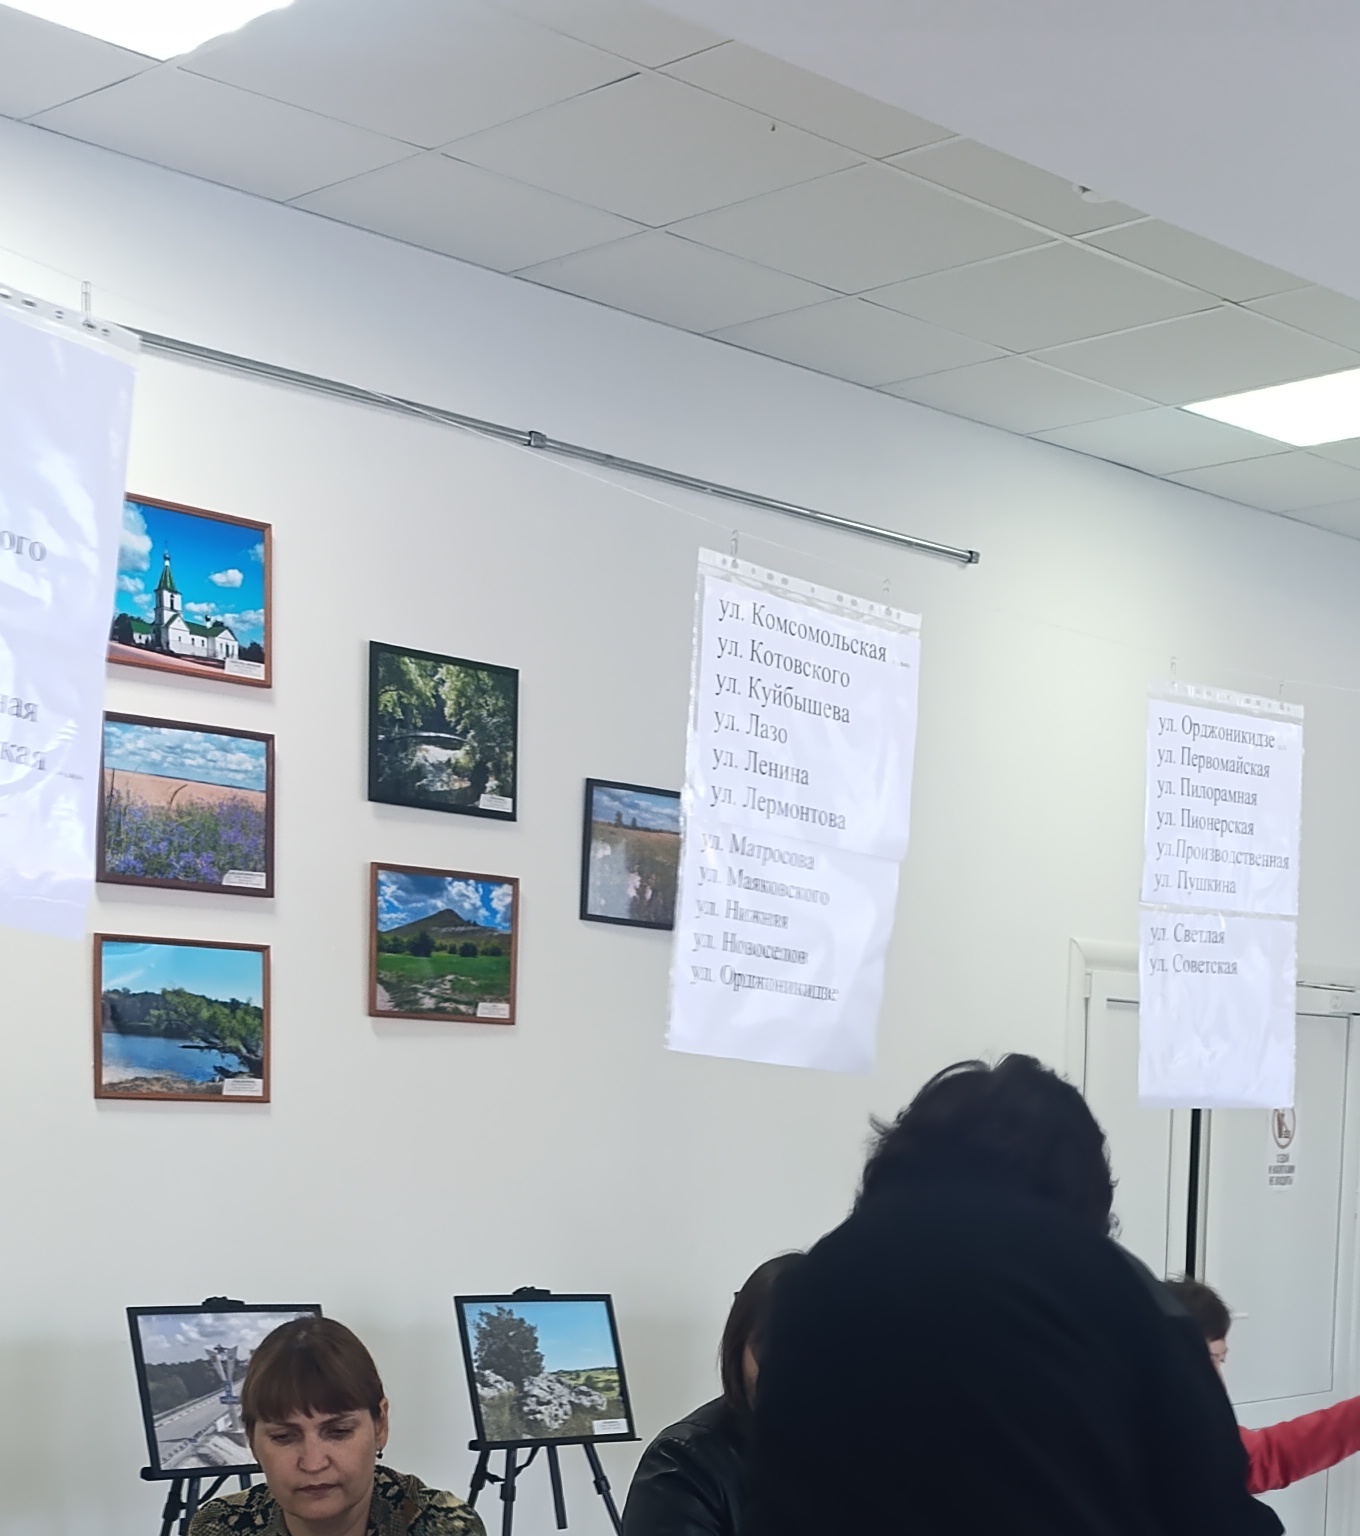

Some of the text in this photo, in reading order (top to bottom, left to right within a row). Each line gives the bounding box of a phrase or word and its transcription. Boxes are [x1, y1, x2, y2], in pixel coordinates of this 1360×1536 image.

[718, 599, 887, 663] ул. Комсомольская
[716, 636, 851, 688] ул. Котовского
[715, 672, 851, 724] ул. Куйбышева
[713, 710, 789, 744] ул. Лазо
[1158, 714, 1275, 749] ул. Орджоникидзе
[712, 748, 810, 786] ул. Ленина
[1156, 746, 1271, 778] ул. Первомайская
[710, 785, 847, 831] ул. Лермонтова
[1156, 777, 1258, 806] ул. Пилорамная
[1156, 808, 1255, 838] ул. Пионерская
[700, 832, 815, 870] ул. Матросова
[697, 866, 831, 906] ул. Маяковского
[1153, 870, 1237, 895] ул. Пушкина
[694, 898, 789, 930] ул. Нижняя
[722, 931, 809, 965] Новоселов
[1149, 923, 1226, 946] ул. Светлая
[1149, 953, 1239, 976] ул. Советская
